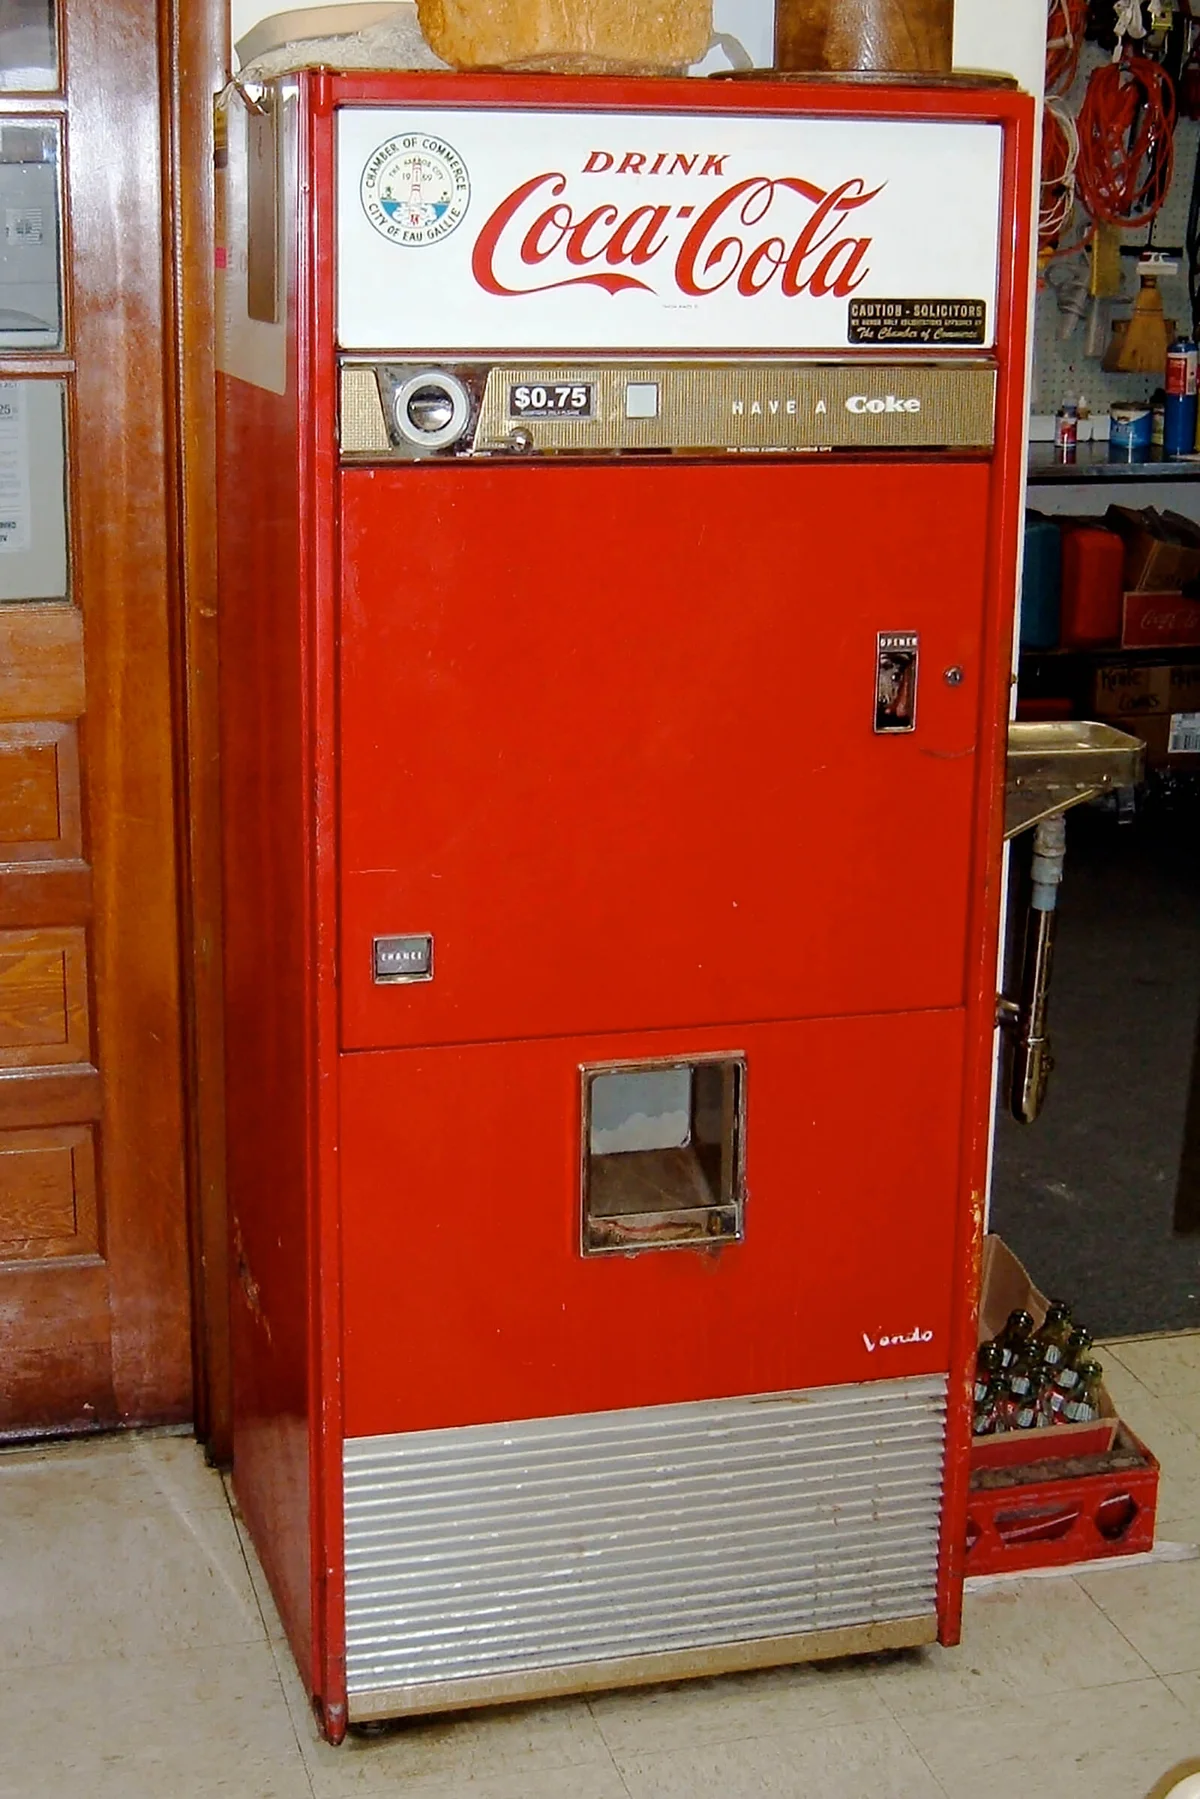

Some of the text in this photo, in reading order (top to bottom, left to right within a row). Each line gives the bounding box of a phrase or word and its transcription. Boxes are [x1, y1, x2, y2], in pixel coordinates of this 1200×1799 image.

[366, 138, 467, 191] CHAMBER OF COMMERCE
[581, 151, 731, 176] DRINK
[368, 203, 461, 242] CITY OF EAU GALLIE
[472, 173, 889, 297] Coca-Cola
[851, 304, 902, 317] CAUTION
[913, 304, 982, 317] SOLICITORS
[515, 387, 587, 410] $0.75
[732, 395, 921, 415] HAVE A Coke
